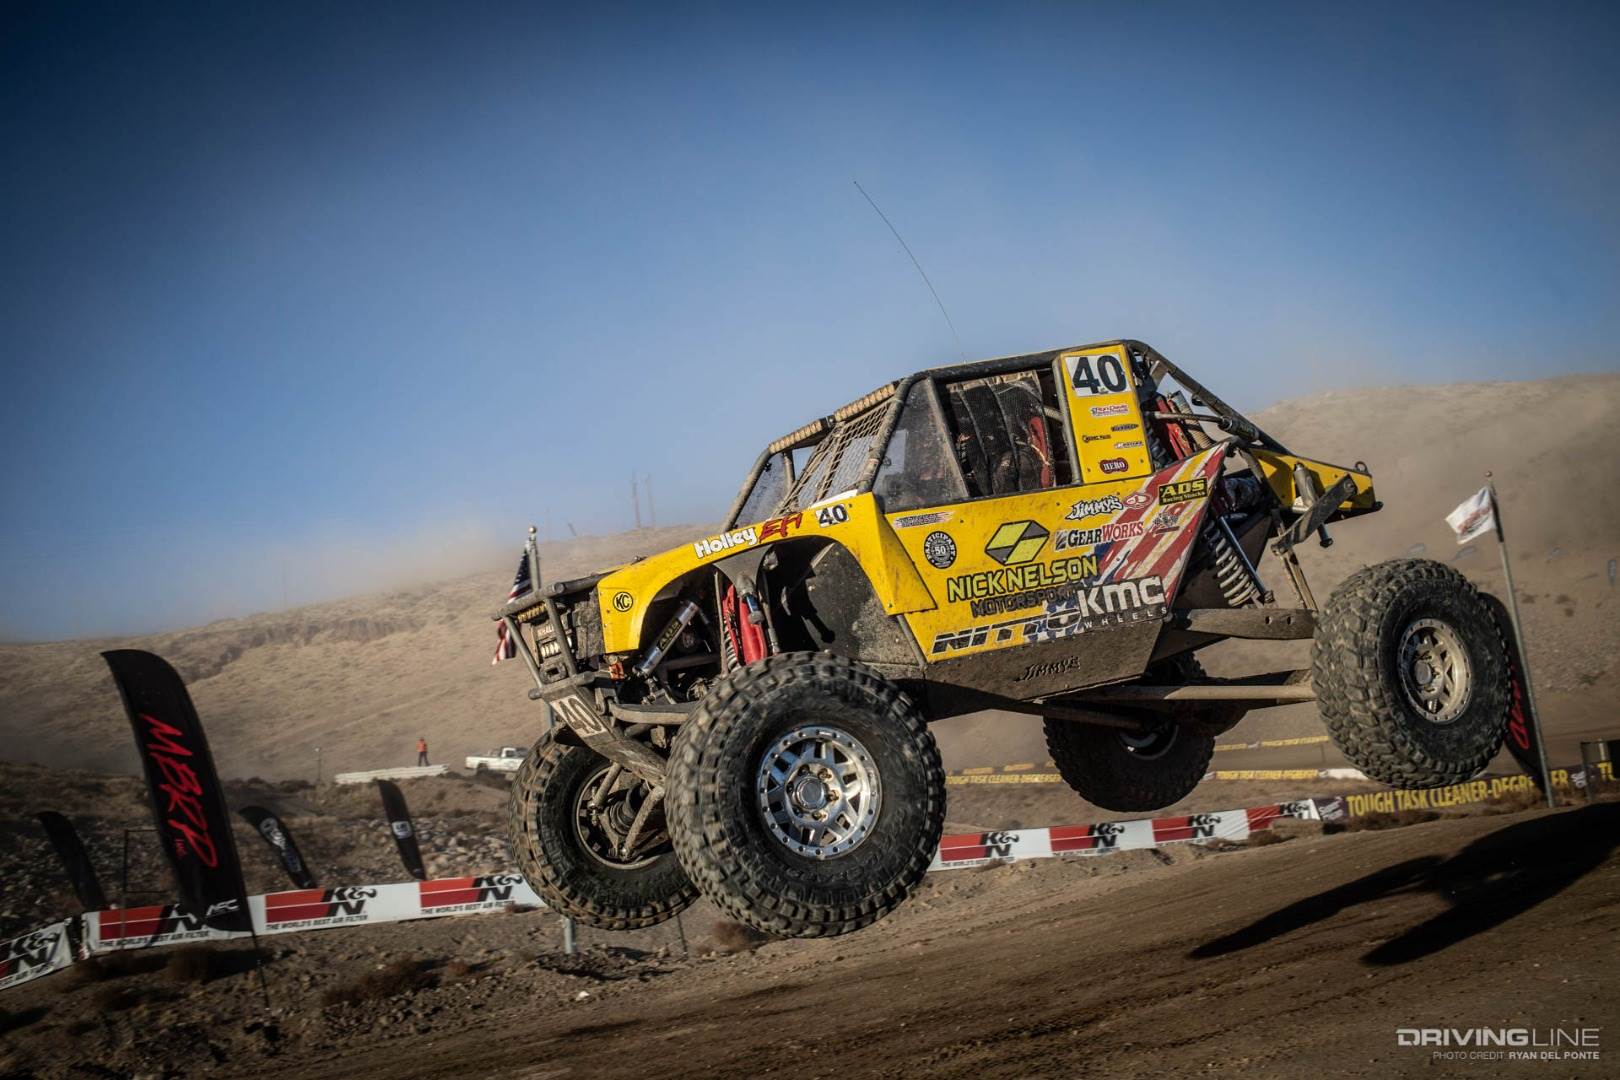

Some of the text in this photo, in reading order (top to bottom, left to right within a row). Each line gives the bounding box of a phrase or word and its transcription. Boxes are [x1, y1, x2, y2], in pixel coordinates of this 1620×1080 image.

[1073, 355, 1127, 394] 40
[1102, 461, 1126, 471] HERO
[1161, 479, 1205, 498] ADS
[818, 504, 847, 526] 40
[694, 526, 759, 559] Holley
[934, 545, 946, 555] 50
[1006, 555, 1099, 591] NELSON
[615, 593, 632, 611] KC
[1083, 607, 1168, 629] WHEELS
[139, 713, 219, 869] MBRP
[1395, 789, 1430, 811] TASK
[1088, 823, 1125, 849] K&N
[1187, 814, 1221, 839] K&N
[980, 832, 1019, 858] K&N
[471, 875, 523, 902] K&N
[321, 886, 377, 917] K&N
